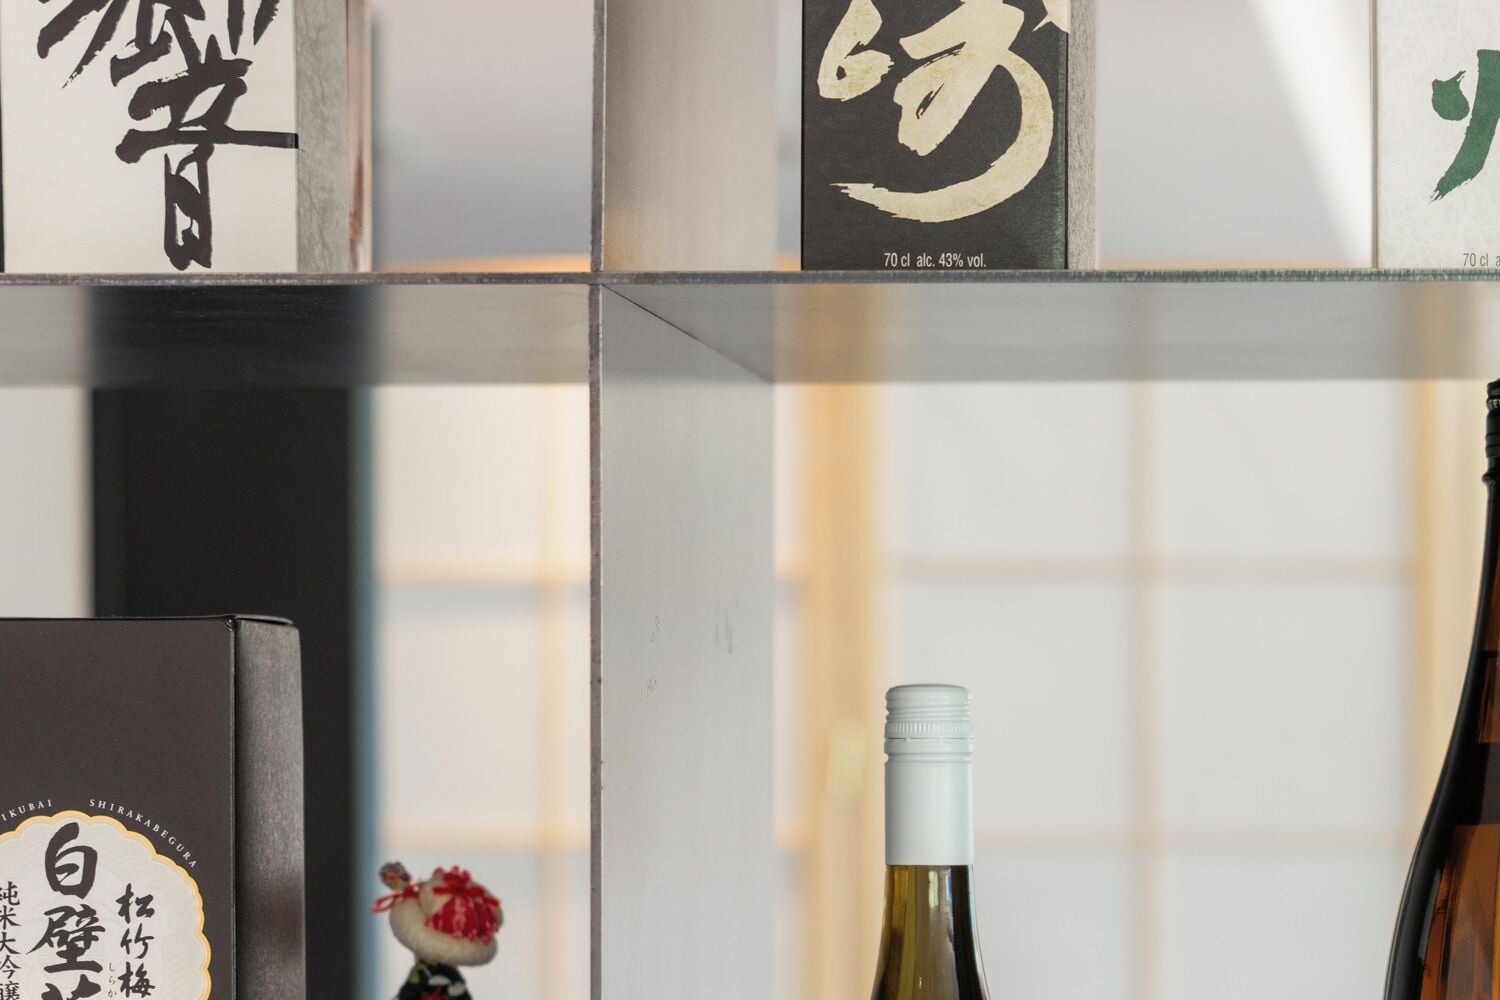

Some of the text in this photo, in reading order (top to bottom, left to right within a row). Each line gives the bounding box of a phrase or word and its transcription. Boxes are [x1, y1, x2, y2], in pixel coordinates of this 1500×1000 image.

[883, 252, 987, 267] 70 cl alc. 43% vol.
[1462, 252, 1477, 267] 70
[1480, 252, 1489, 267] cl
[89, 798, 197, 868] SHIRAKABEGURA
[115, 883, 156, 998] 松竹梅
